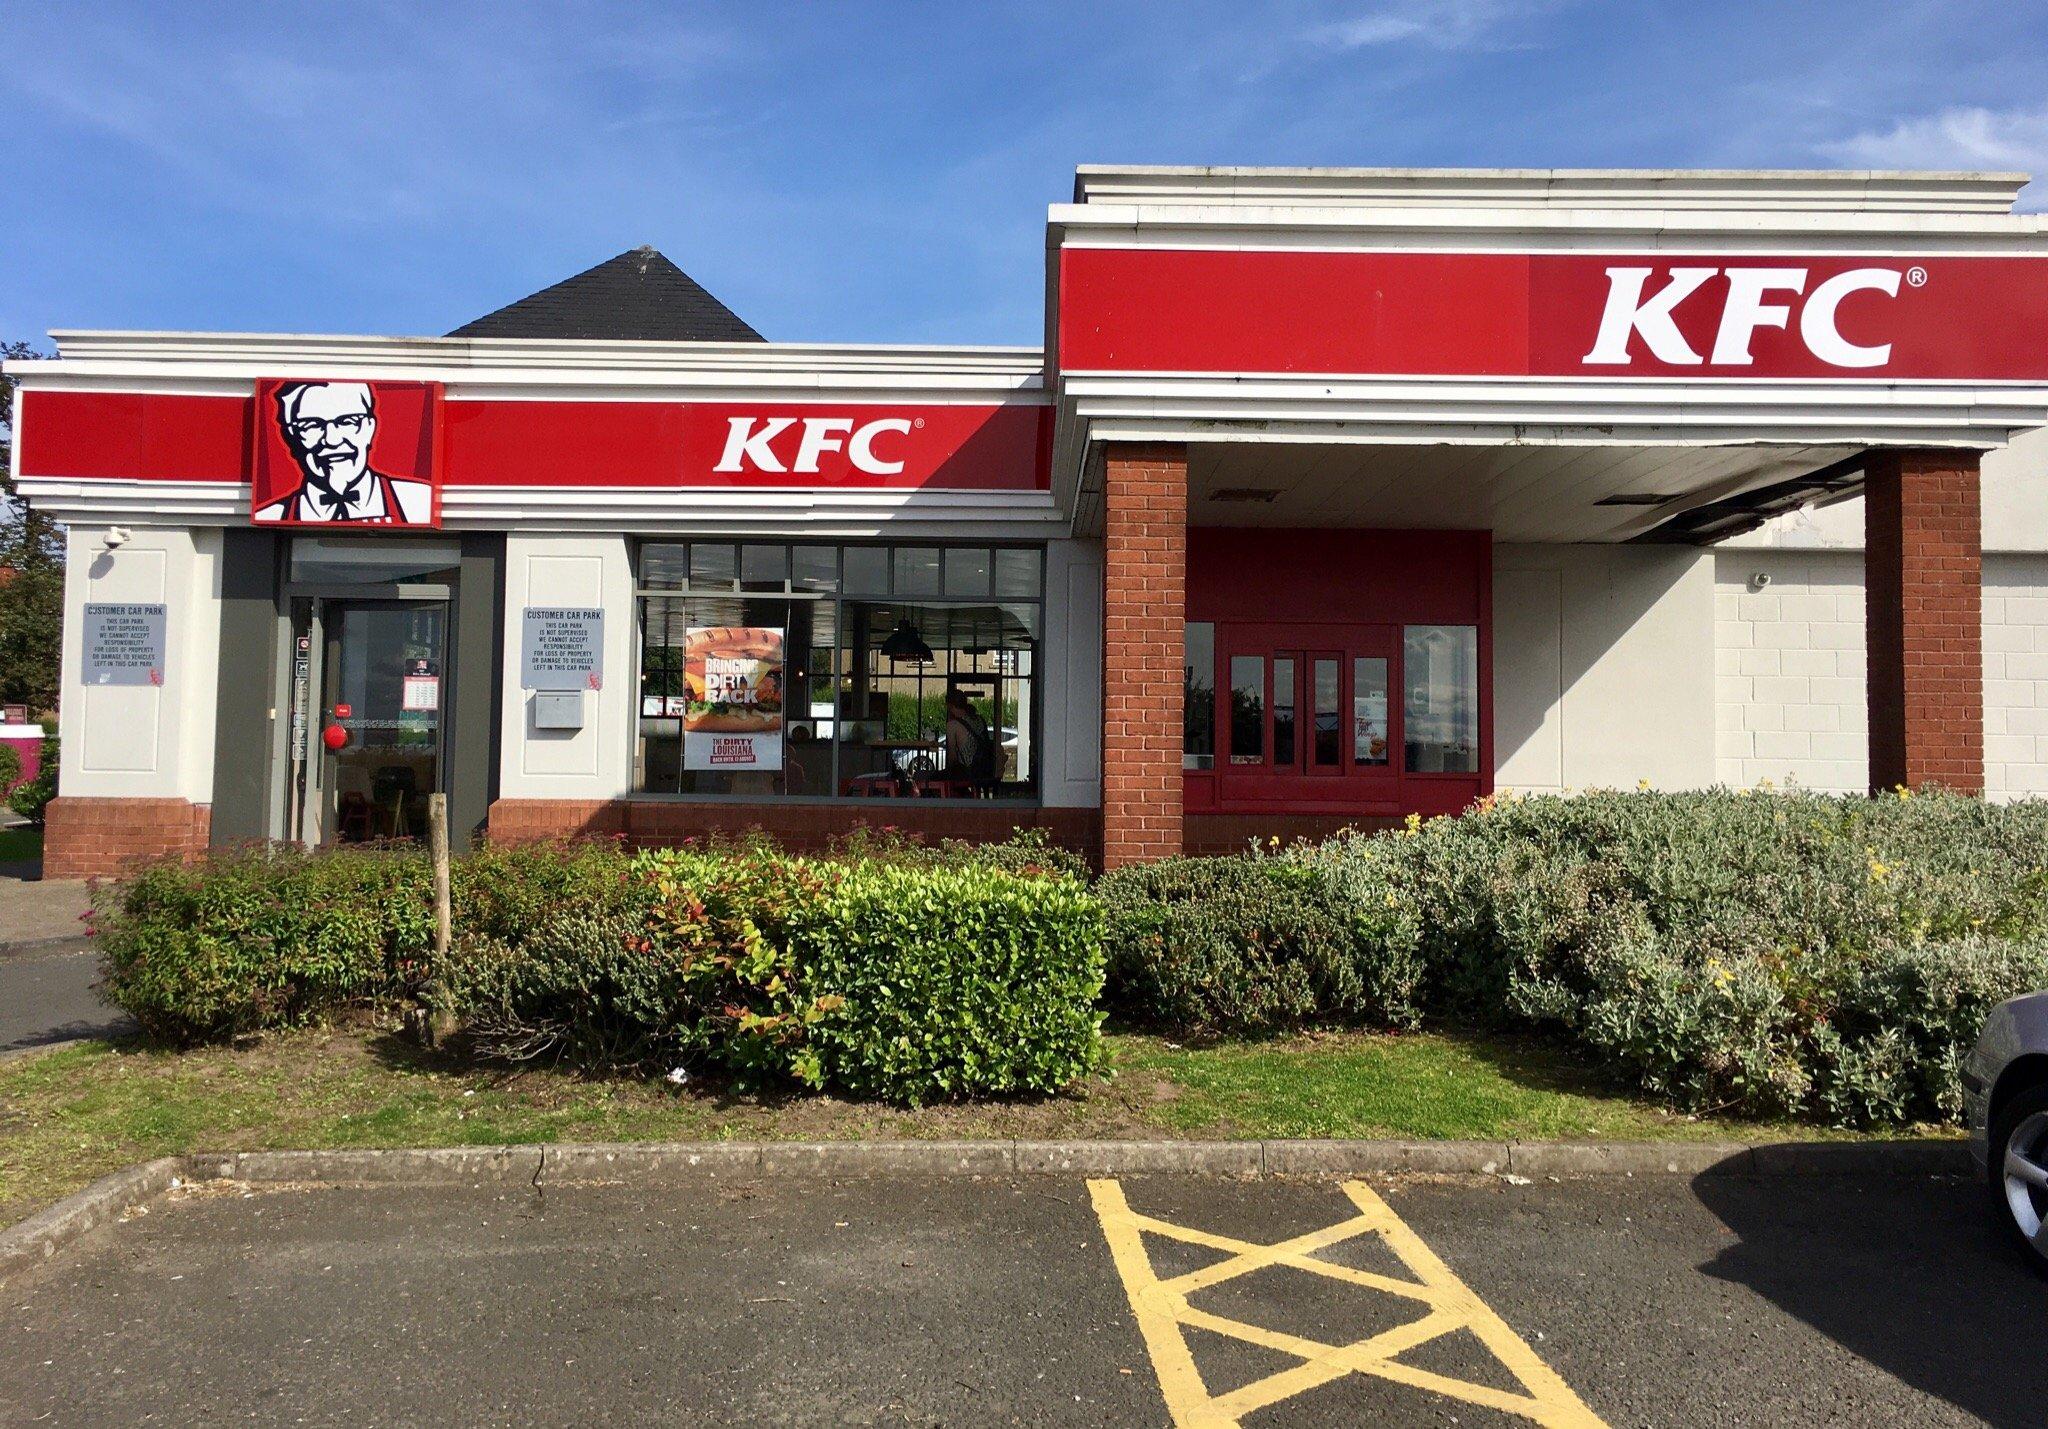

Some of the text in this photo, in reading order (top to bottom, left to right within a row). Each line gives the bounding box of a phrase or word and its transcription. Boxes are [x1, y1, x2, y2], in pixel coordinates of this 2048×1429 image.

[88, 606, 163, 615] CUSTOMER CAR PARK
[527, 611, 601, 620] CUSTOMER CAR PARK
[705, 658, 759, 674] BRINGING
[705, 674, 758, 689] DIRTY
[705, 689, 758, 703] BACK
[713, 746, 753, 755] LOUISIANA
